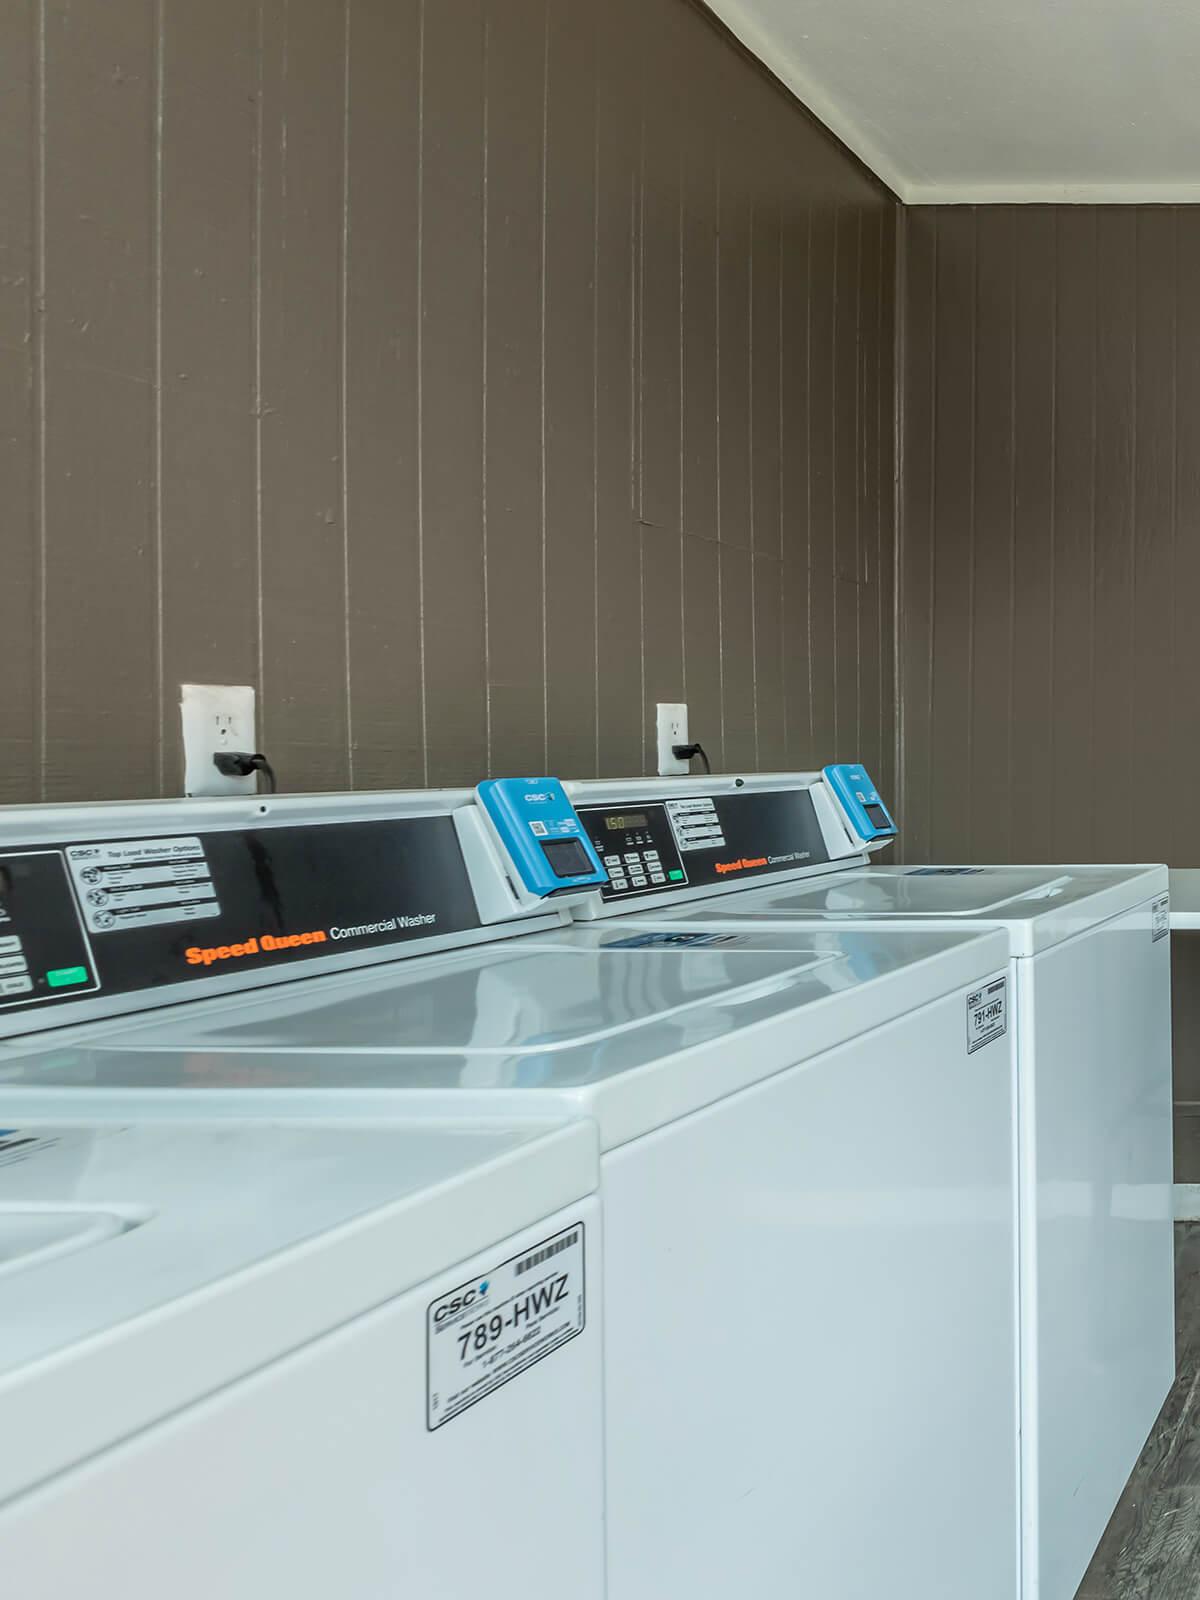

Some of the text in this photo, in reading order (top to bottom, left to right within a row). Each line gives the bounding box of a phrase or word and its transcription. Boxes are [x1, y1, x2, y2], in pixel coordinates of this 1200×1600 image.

[524, 793, 546, 802] CSC
[715, 859, 742, 874] Speed
[742, 857, 768, 868] Queen
[185, 913, 437, 965] Speed Queen Commercial Washer
[434, 1289, 477, 1323] CSC
[457, 1273, 570, 1361] 789-HWZ
